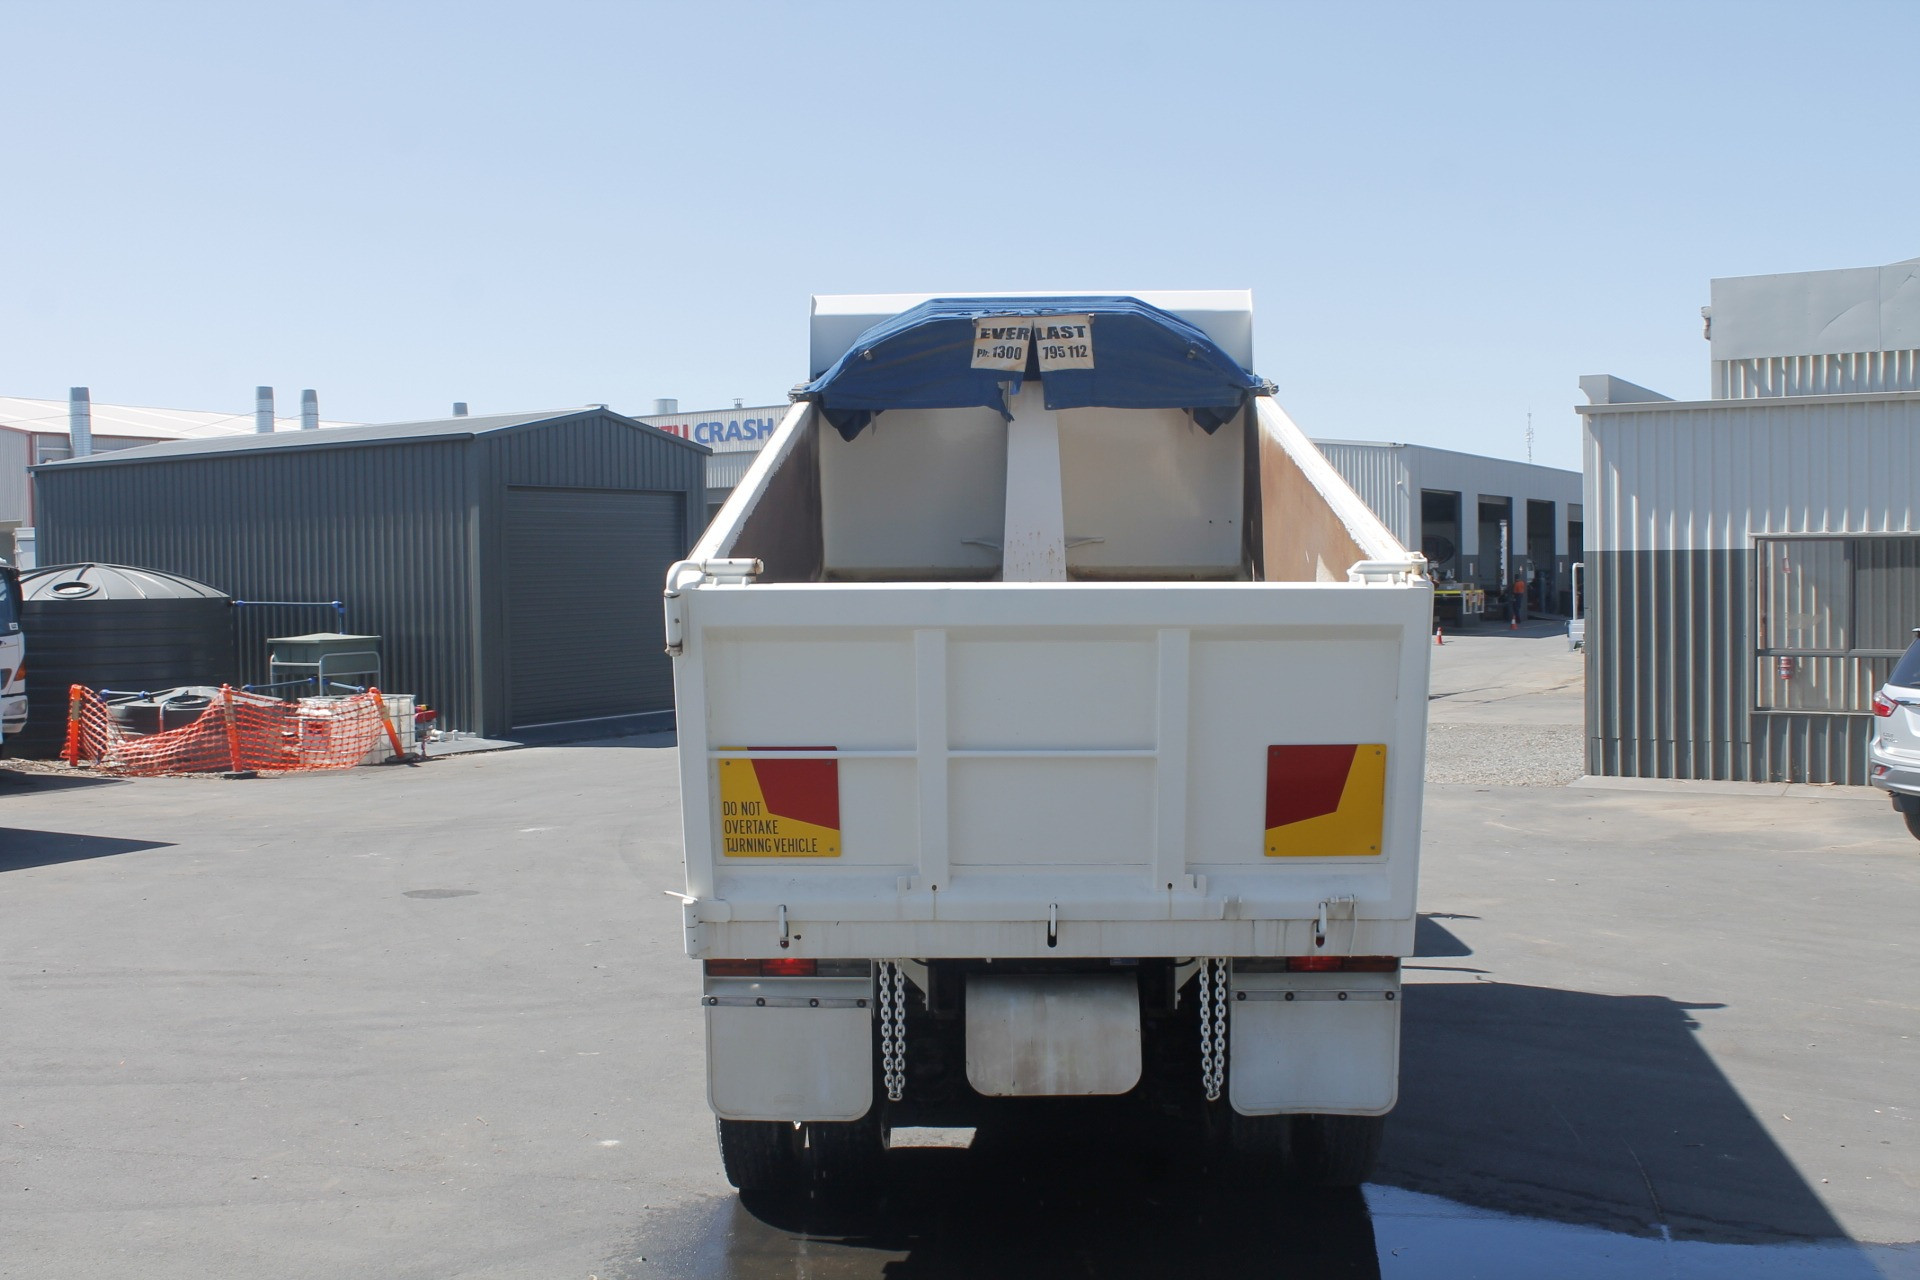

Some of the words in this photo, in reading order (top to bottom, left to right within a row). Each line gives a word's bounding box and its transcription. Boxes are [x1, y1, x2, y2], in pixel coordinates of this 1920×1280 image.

[992, 345, 1022, 361] 1300
[1042, 345, 1066, 360] 795
[1067, 344, 1088, 359] 112
[694, 418, 773, 443] CRASH
[723, 801, 738, 816] DO
[741, 801, 761, 816] NOT
[724, 819, 779, 835] OVERTAKE
[725, 837, 772, 853] TURNING
[773, 837, 818, 853] VEHICLE
